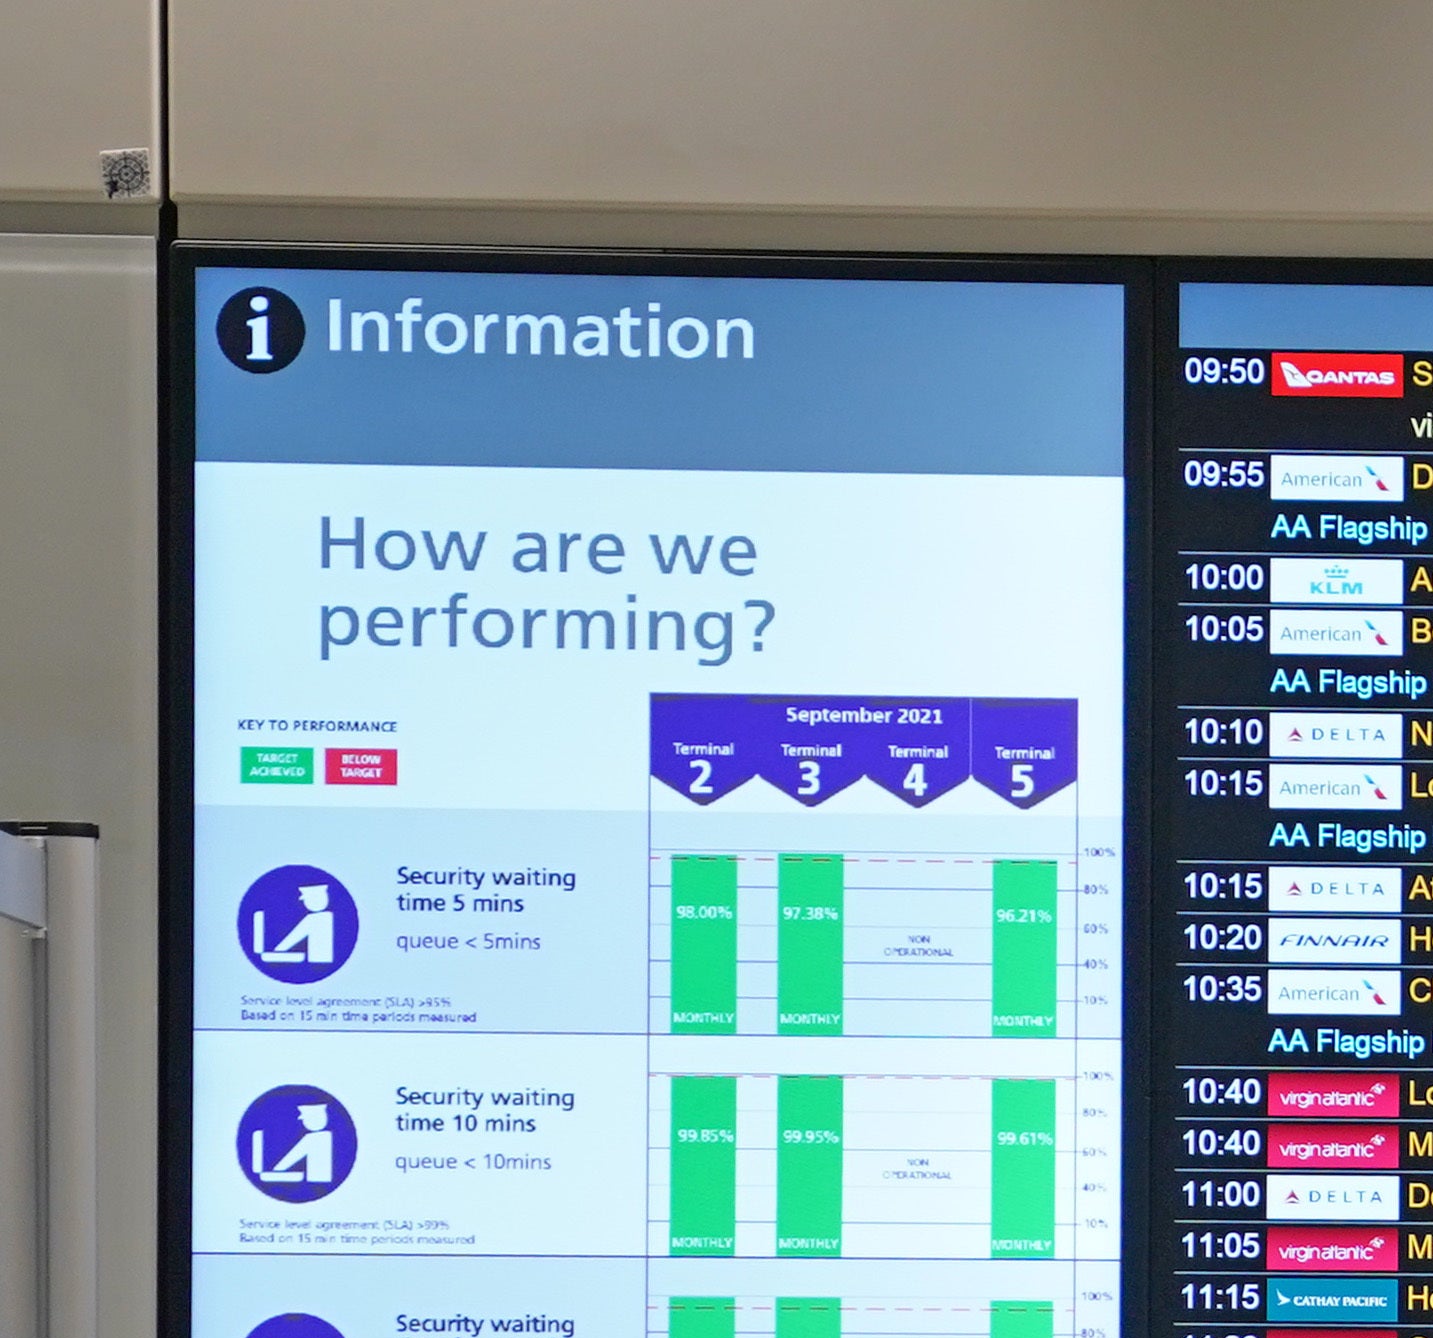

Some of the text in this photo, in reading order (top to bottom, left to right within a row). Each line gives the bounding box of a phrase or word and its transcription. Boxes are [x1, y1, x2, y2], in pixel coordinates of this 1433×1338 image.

[329, 298, 753, 358] Information
[1185, 357, 1265, 384] 09:50
[1304, 370, 1395, 387] QANTAS
[1185, 460, 1264, 487] 09:55
[1271, 514, 1312, 538] AA
[1320, 515, 1428, 545] Flagship
[321, 516, 756, 576] How are we
[321, 593, 775, 666] performing?
[239, 720, 397, 732] KEY TO PERFORMANCE
[787, 707, 942, 726] September 2021
[1186, 718, 1263, 744] 10:10
[673, 743, 734, 755] Terminal
[781, 744, 842, 757] Terminal
[888, 745, 948, 758] Terminal
[995, 747, 1054, 759] Terminal
[690, 760, 713, 793] 2
[798, 761, 820, 794] 3
[903, 764, 927, 796] 4
[1011, 765, 1034, 797] 5
[398, 866, 575, 891] Security waiting
[397, 893, 524, 912] time 5 mins
[783, 907, 838, 920] 97.38%
[997, 909, 1052, 922] 96.21%
[397, 936, 458, 952] queue
[484, 933, 540, 950] 5mins
[1182, 1284, 1260, 1309] 11:15
[397, 1314, 574, 1338] Security waiting
